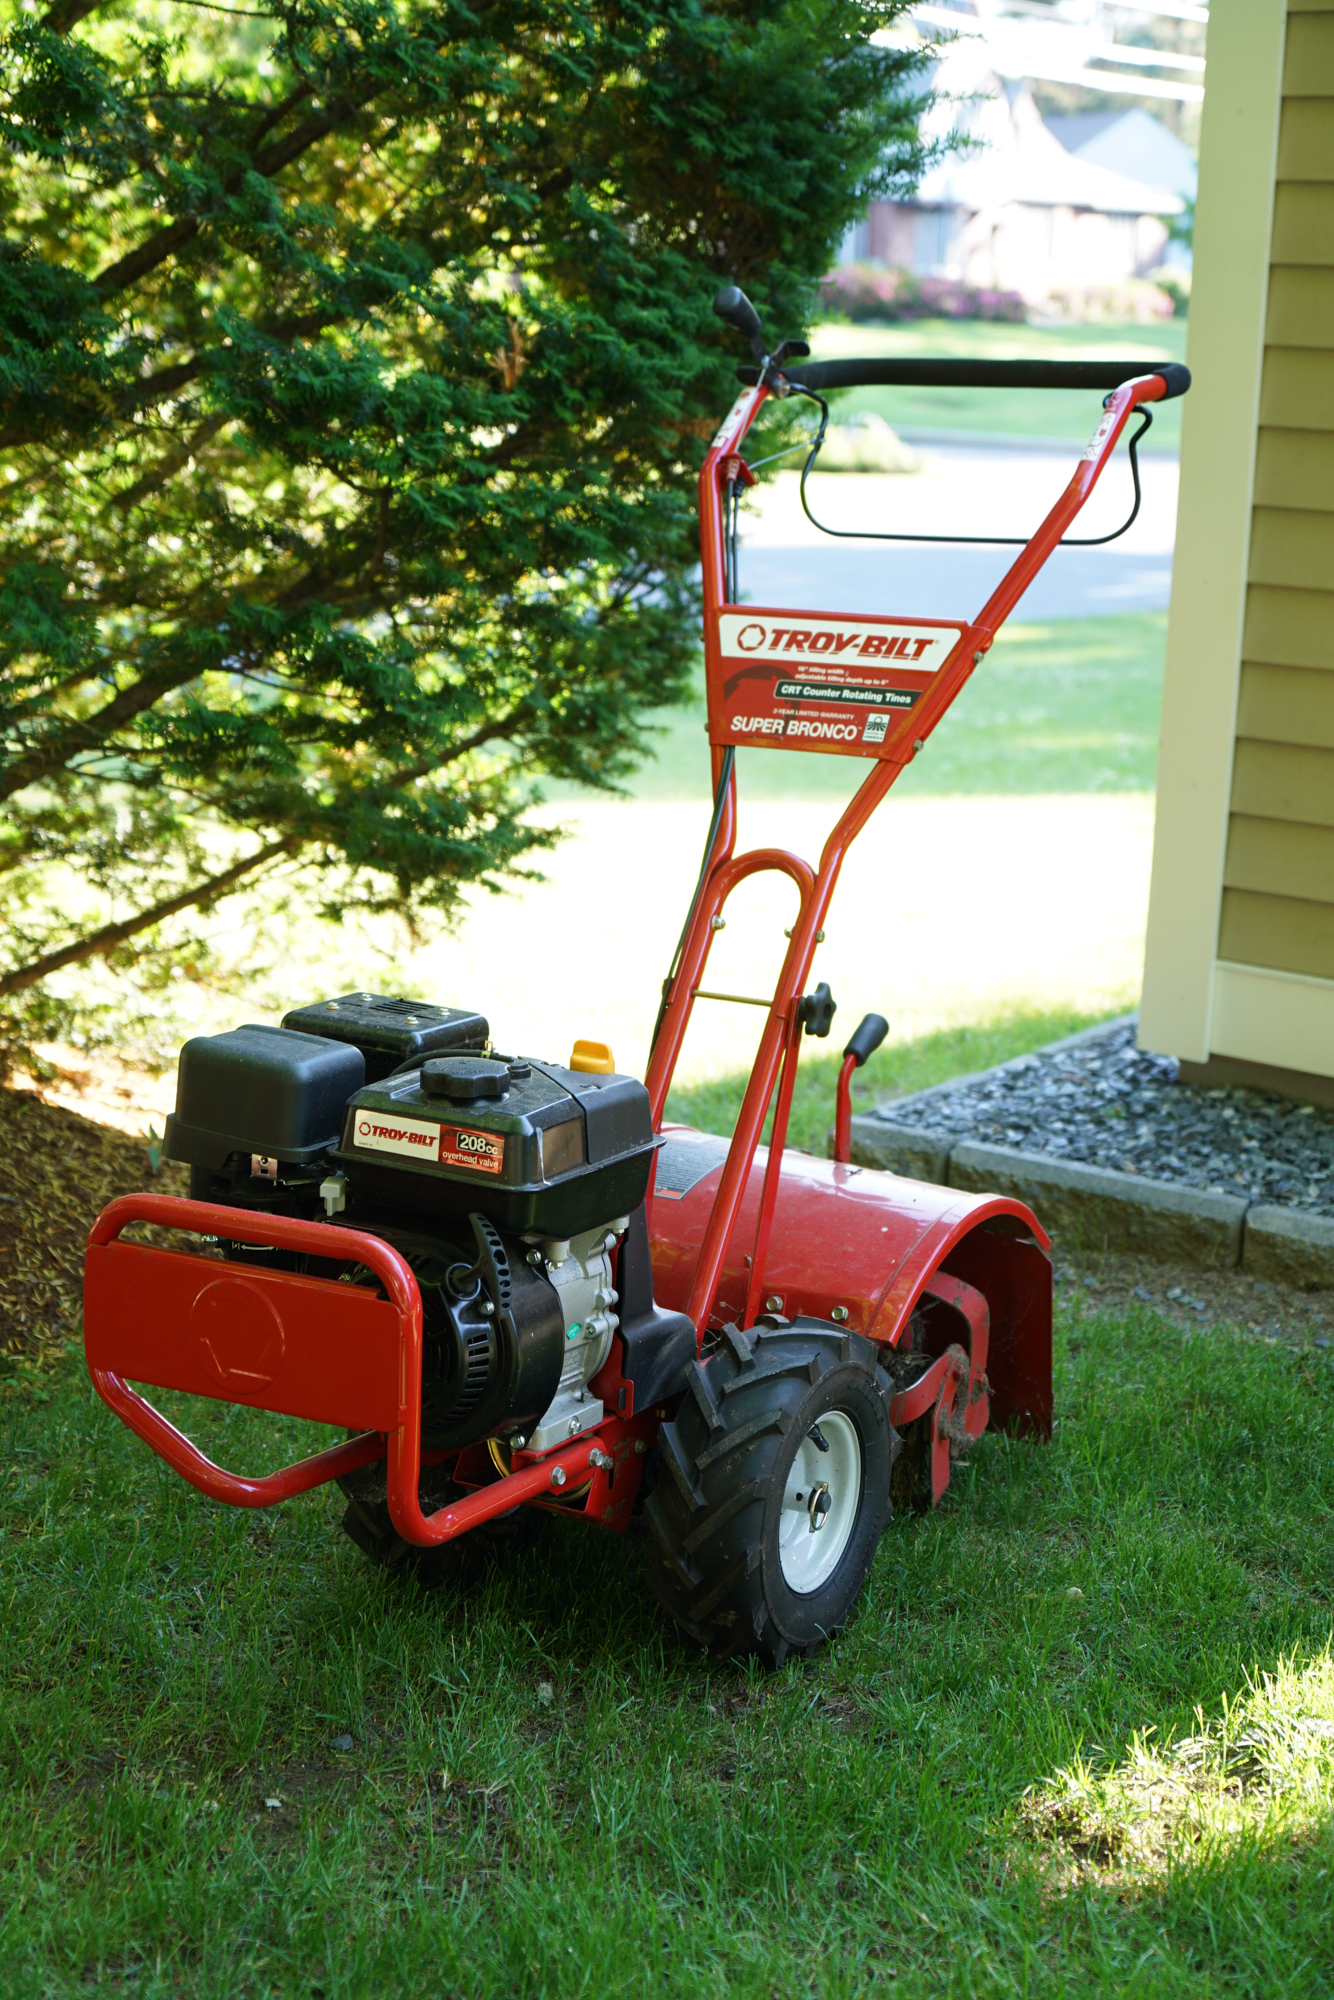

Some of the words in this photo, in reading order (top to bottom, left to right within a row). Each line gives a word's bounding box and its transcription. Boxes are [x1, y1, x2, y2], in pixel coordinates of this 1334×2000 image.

[767, 628, 935, 661] TROY-BILT
[795, 673, 826, 681] adjustable
[827, 675, 845, 683] tilling
[781, 684, 802, 695] CRT
[803, 686, 841, 698] Counter
[842, 689, 883, 702] Rotating
[885, 693, 912, 704] Tines
[795, 709, 819, 717] LIMITED
[820, 711, 854, 720] WARRANTY
[730, 715, 785, 735] SUPER
[786, 720, 858, 740] BRONCO
[372, 1125, 437, 1147] TROY-BILT
[459, 1134, 499, 1155] 208cc
[442, 1151, 478, 1164] overhead
[479, 1157, 499, 1168] valve
